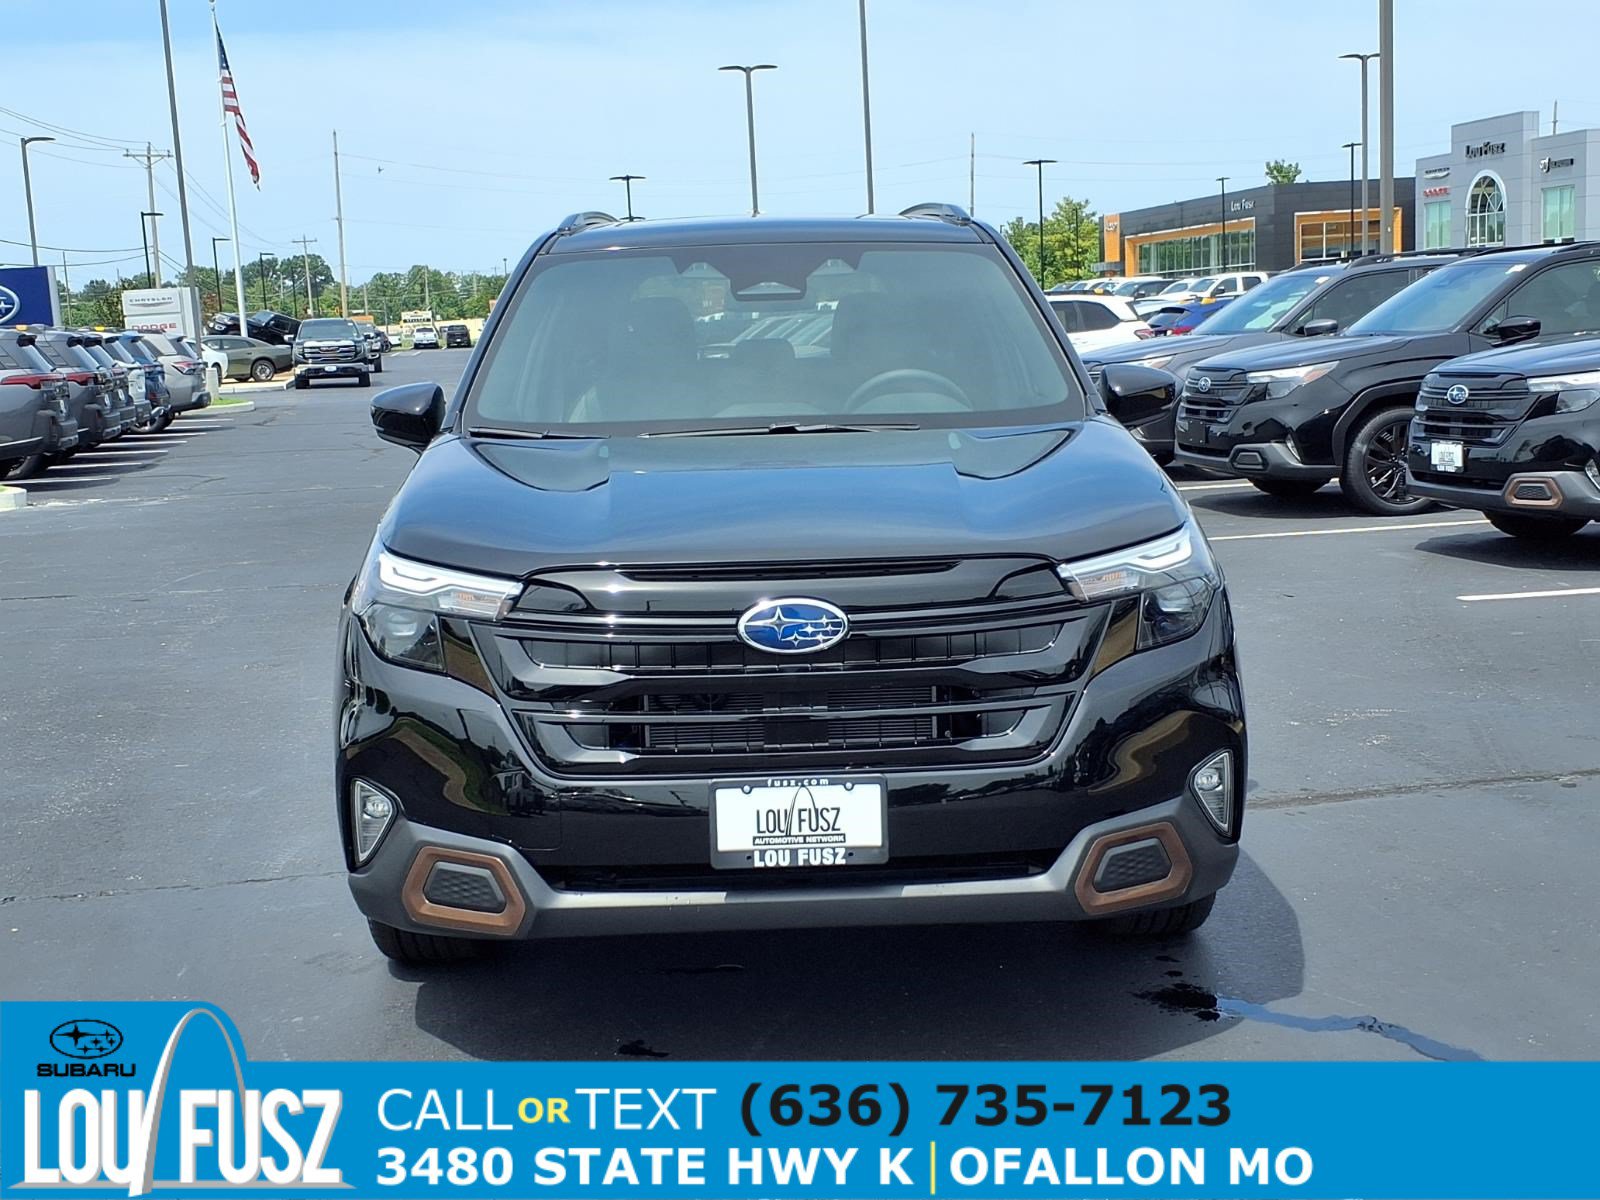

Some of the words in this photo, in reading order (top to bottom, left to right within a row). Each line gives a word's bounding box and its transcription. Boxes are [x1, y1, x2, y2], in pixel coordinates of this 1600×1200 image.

[767, 778, 829, 787] fusz.com
[756, 809, 788, 833] LOU
[798, 807, 841, 832] FUSZ
[754, 837, 804, 845] AUTOMOTIVE
[806, 834, 845, 844] NETWORK
[753, 849, 790, 867] LOU
[798, 848, 846, 865] FUSZ
